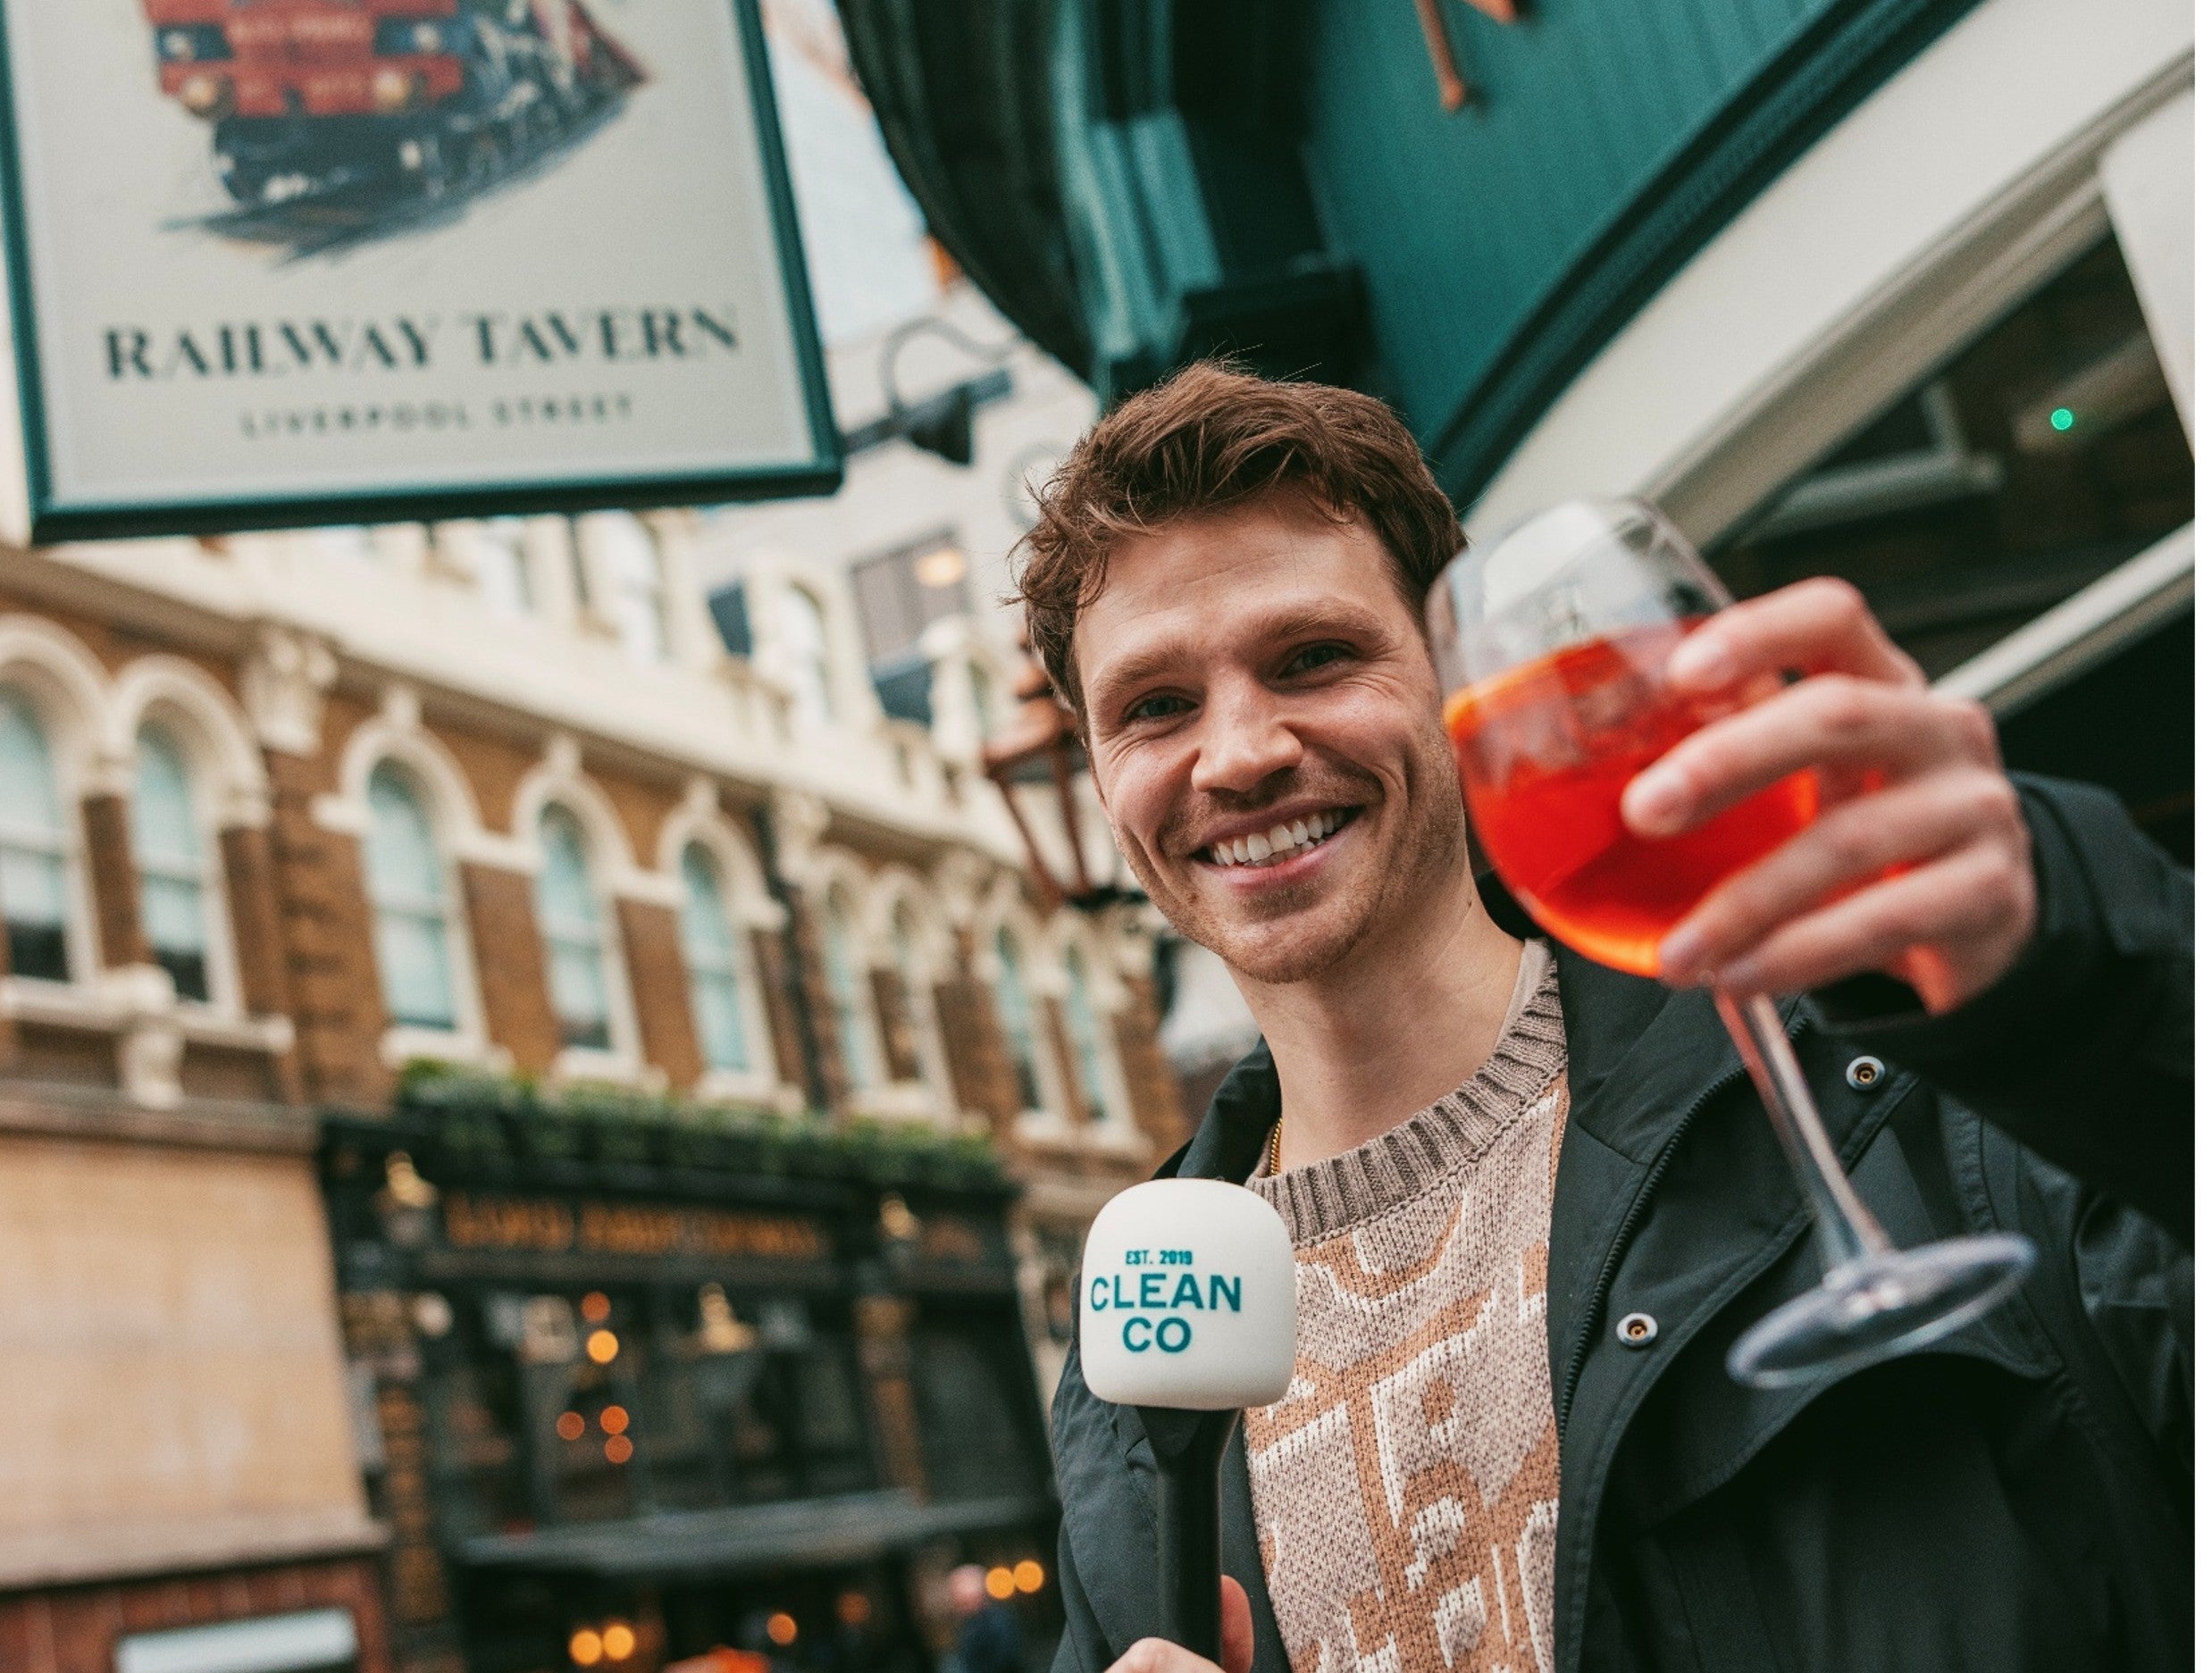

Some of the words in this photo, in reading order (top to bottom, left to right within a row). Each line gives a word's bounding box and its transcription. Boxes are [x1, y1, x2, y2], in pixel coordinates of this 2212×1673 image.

[105, 315, 438, 381] RAILWAY
[457, 302, 742, 364] TAVERN
[239, 401, 471, 440] LIVERPOOL
[491, 393, 633, 432] STREET
[1126, 1250, 1153, 1265] EST.
[1160, 1250, 1193, 1265] 2019
[1091, 1273, 1241, 1312] CLEAN
[1123, 1317, 1192, 1353] CO
